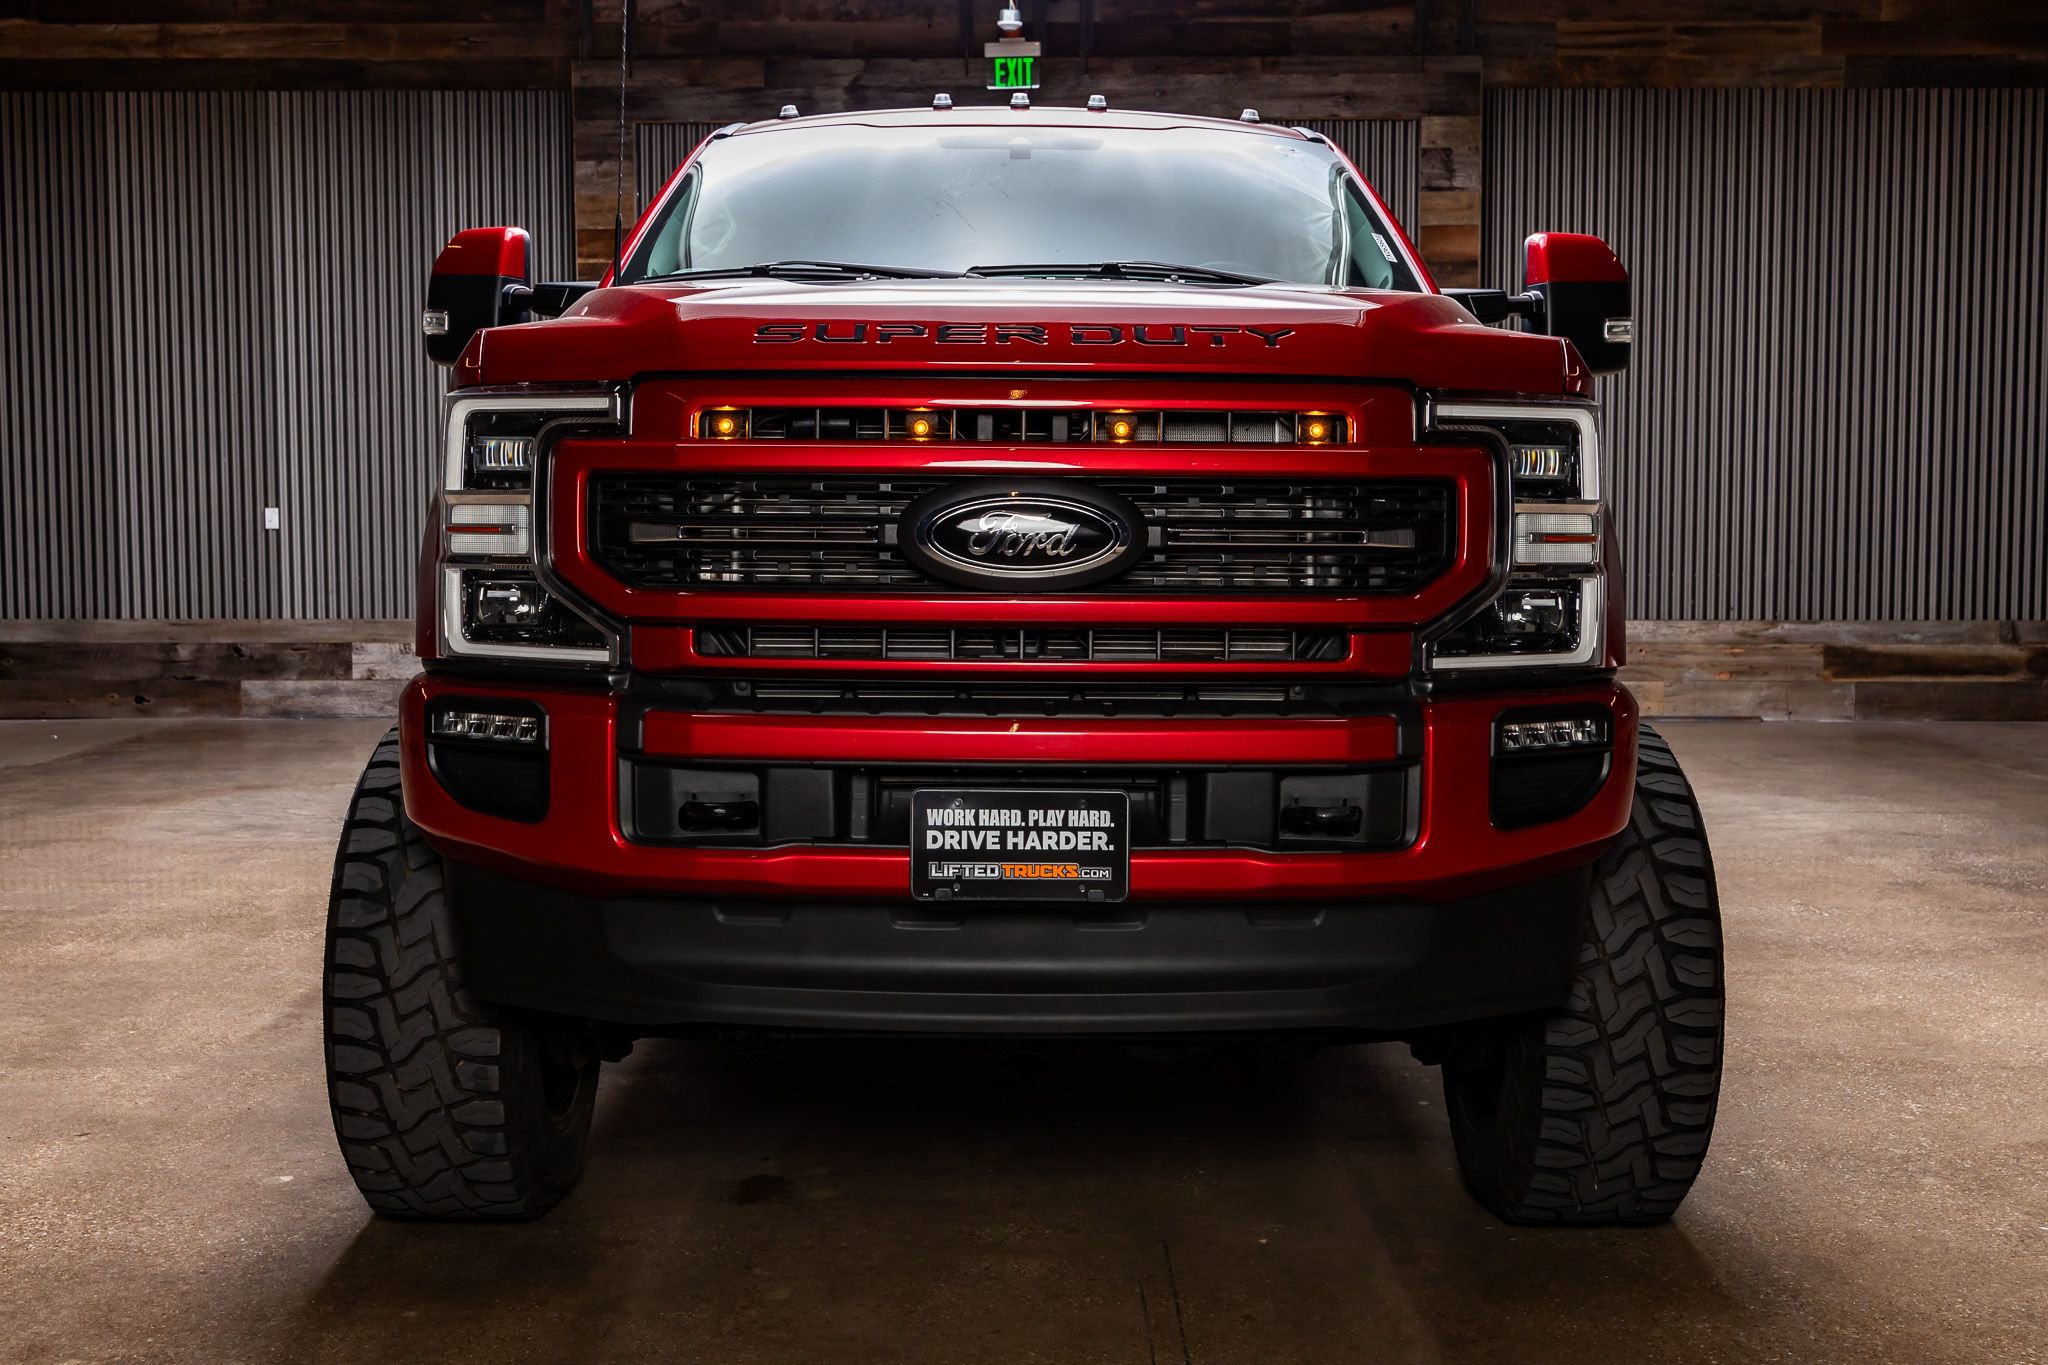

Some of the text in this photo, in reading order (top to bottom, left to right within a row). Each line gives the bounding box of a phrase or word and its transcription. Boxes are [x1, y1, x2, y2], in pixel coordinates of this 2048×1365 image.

[994, 57, 1034, 88] EXIT
[752, 323, 1297, 348] SUPER DUTY
[966, 510, 1081, 557] Ford
[926, 808, 1115, 828] WORK HARD. PLAY HARD.
[926, 829, 1115, 851] DRIVE HARDER.
